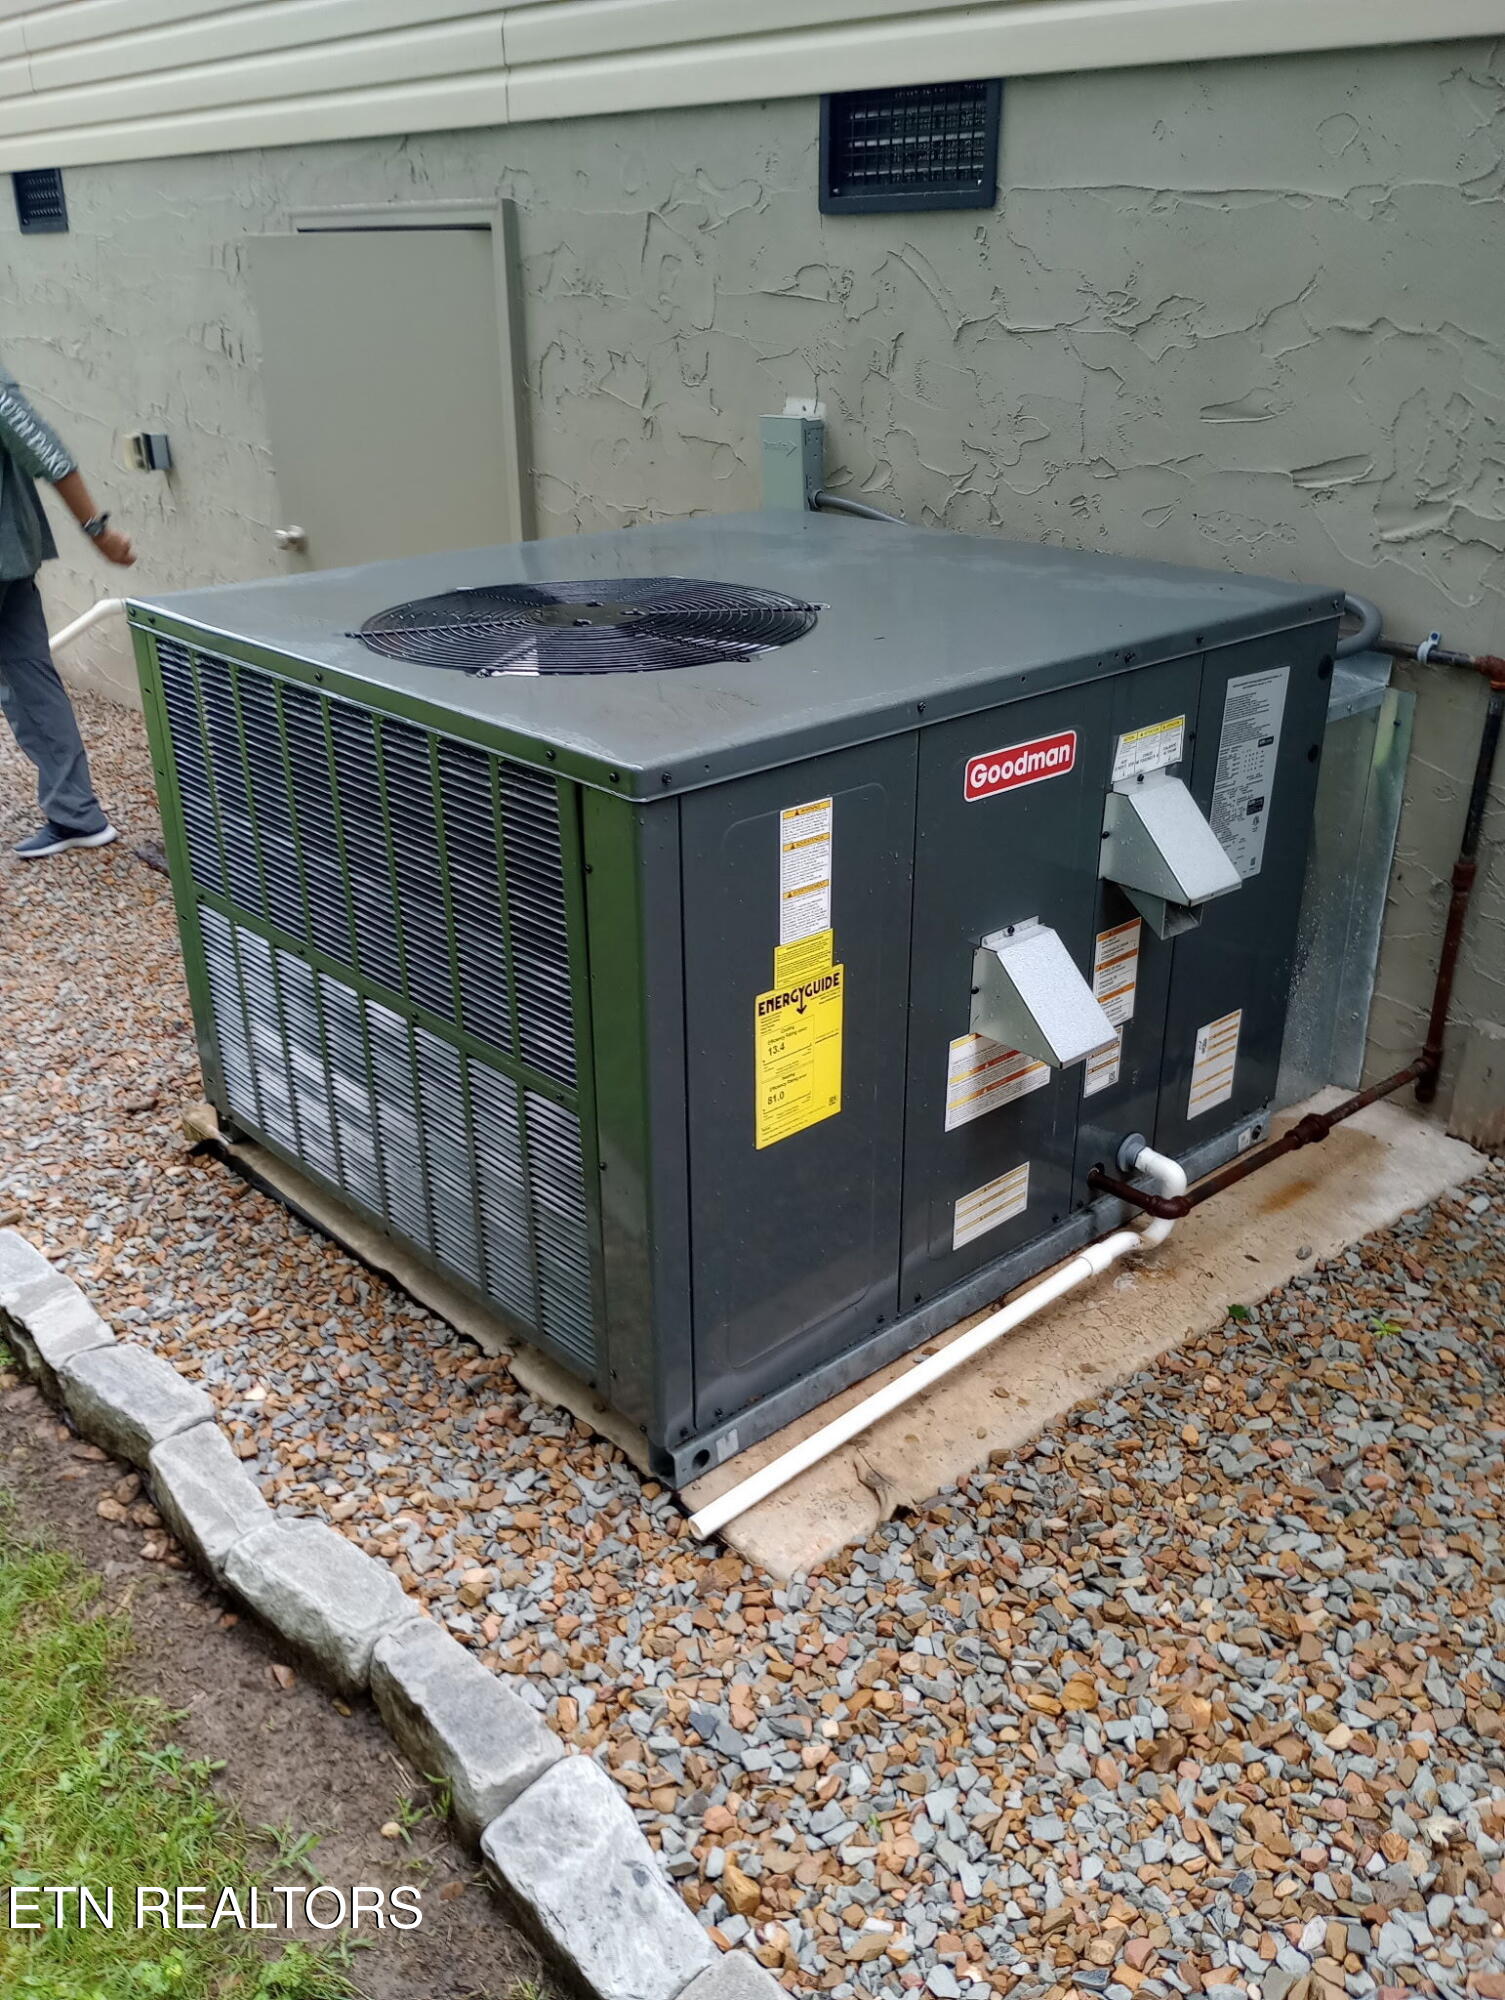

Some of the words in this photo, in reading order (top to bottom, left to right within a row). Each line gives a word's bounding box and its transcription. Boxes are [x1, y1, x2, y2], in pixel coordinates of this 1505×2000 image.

[970, 744, 1071, 789] Goodman
[758, 972, 840, 1016] ENERGYGUIDE
[768, 1042, 785, 1056] 13.4
[767, 1090, 785, 1105] 81.0
